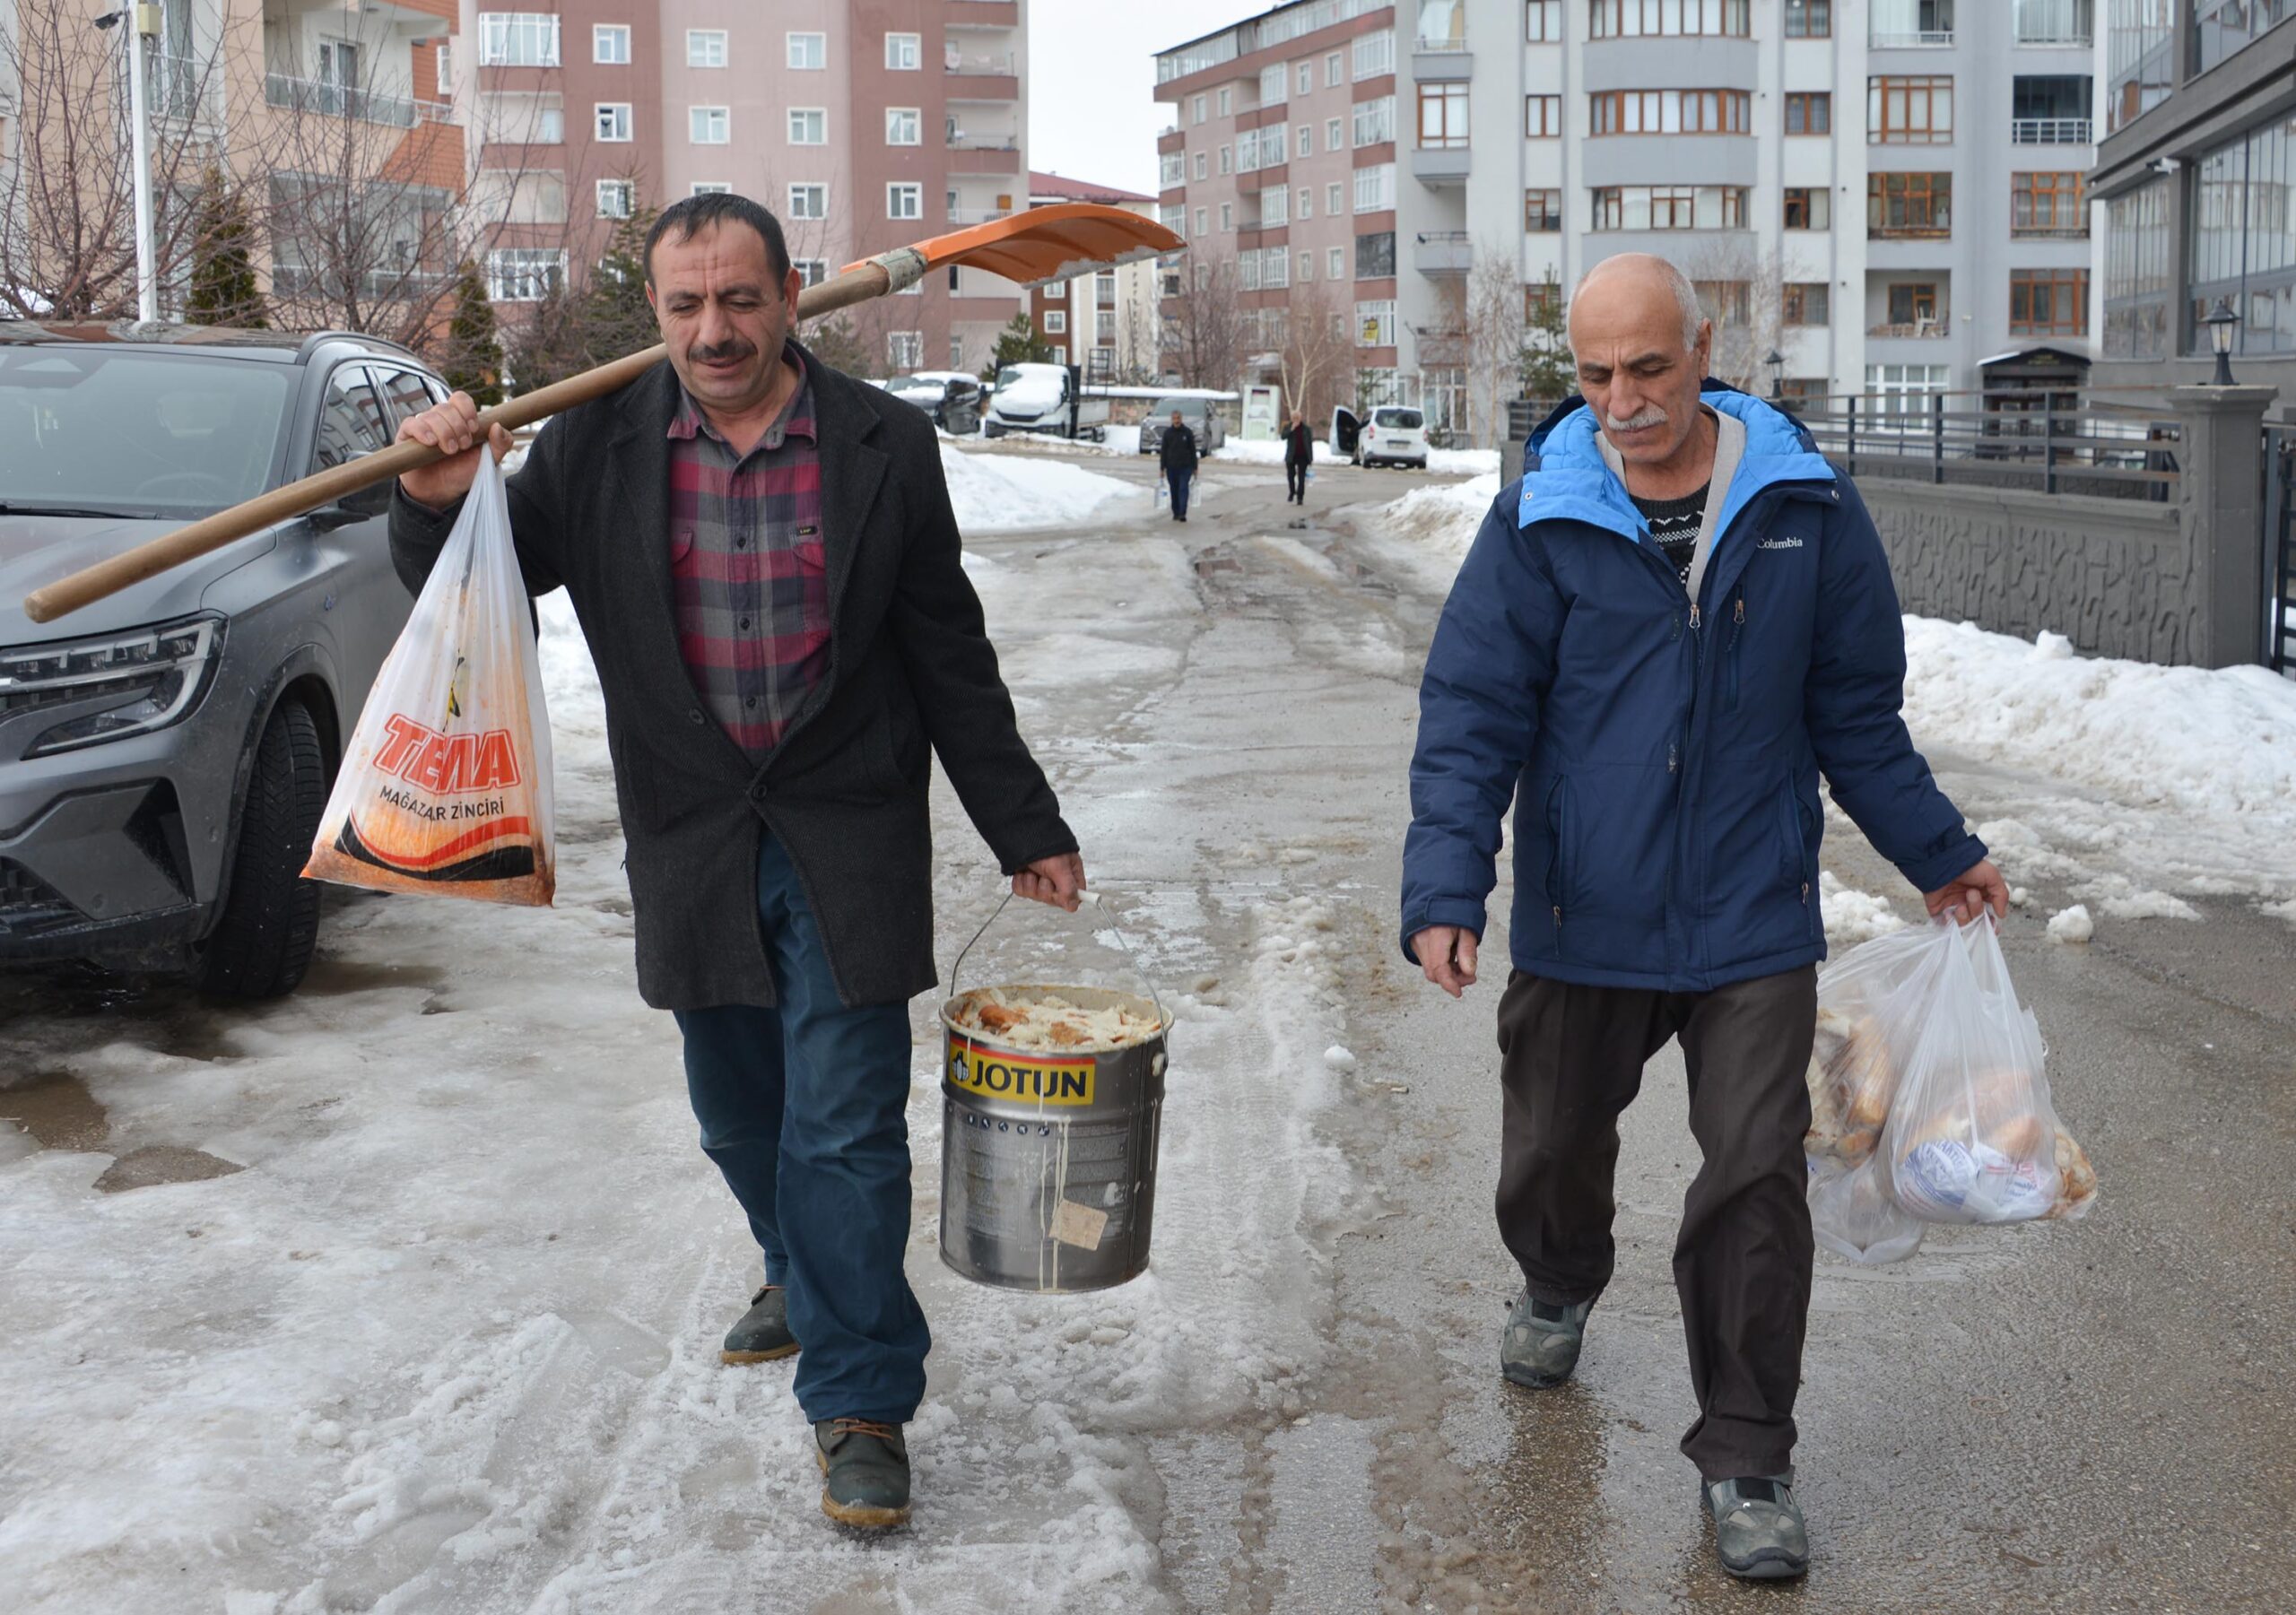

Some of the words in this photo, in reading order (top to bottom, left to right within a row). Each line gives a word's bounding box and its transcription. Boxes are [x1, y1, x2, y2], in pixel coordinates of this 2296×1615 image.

[1757, 536, 1803, 550] Columbia
[451, 796, 504, 820] ZİNCİRİ
[971, 1060, 1087, 1098] JOTUN
